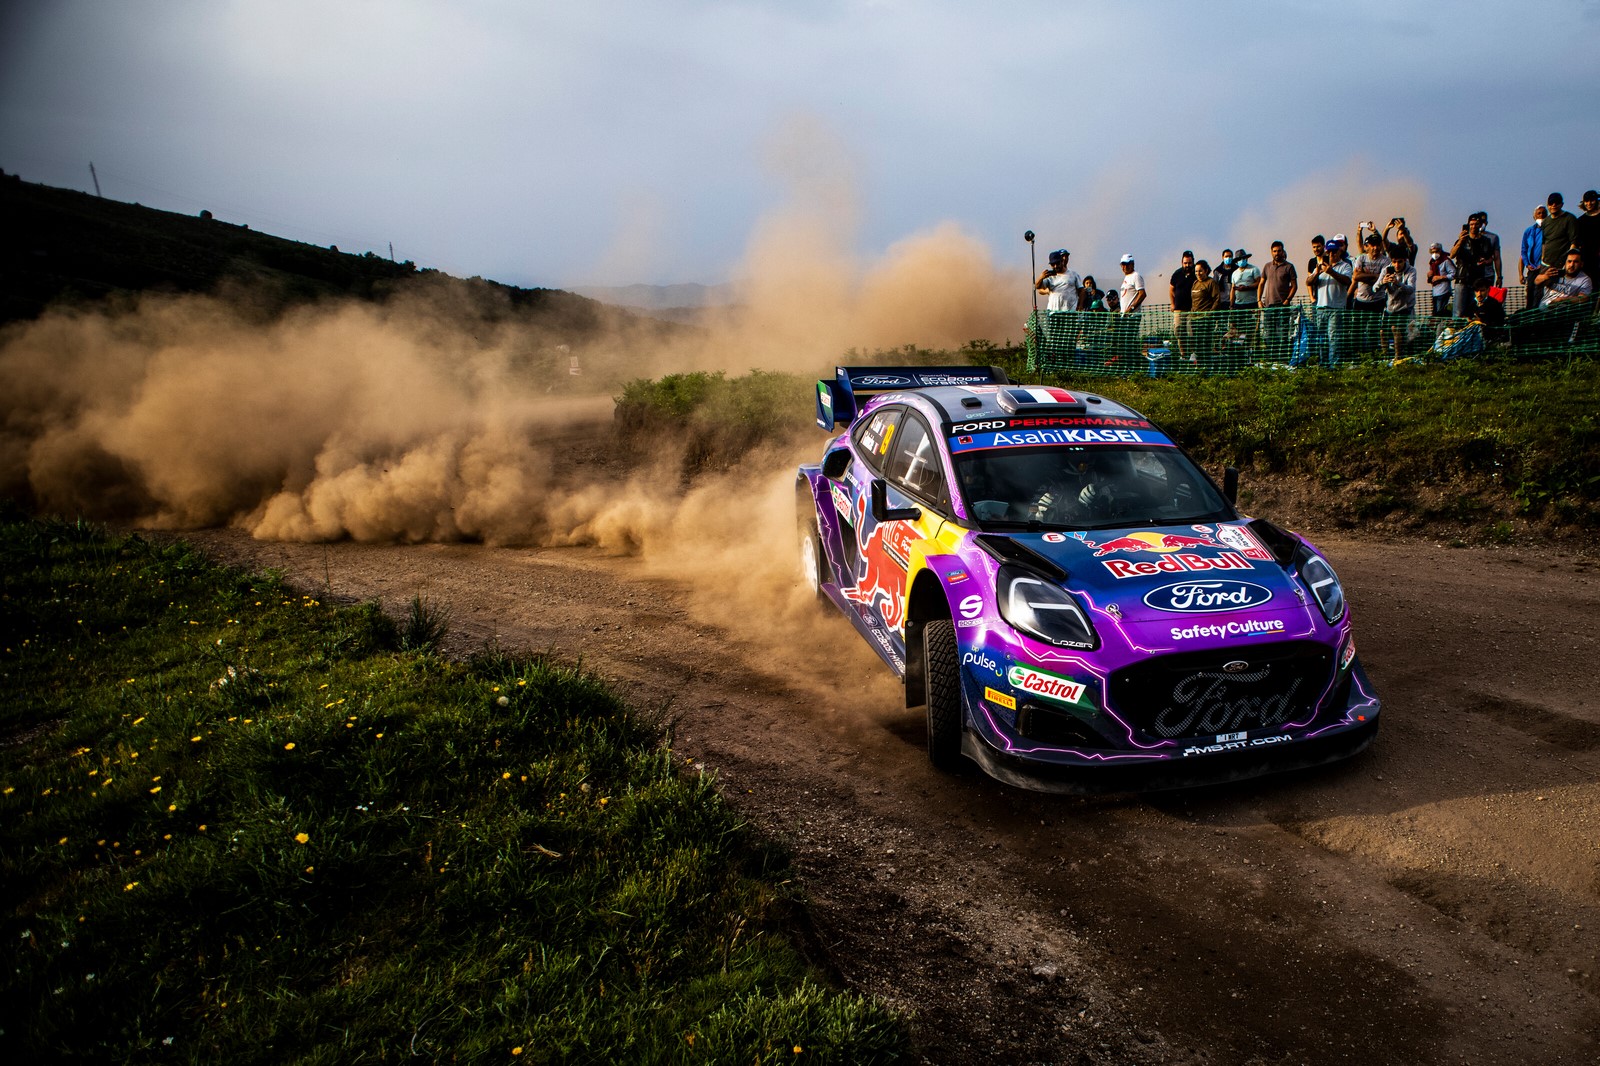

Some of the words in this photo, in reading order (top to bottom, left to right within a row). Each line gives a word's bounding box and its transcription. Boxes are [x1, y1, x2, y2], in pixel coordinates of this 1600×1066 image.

[861, 376, 901, 385] Ford
[952, 420, 1006, 434] FORD
[1009, 418, 1152, 428] PERFORMANCE
[1104, 554, 1186, 578] Red
[1178, 552, 1252, 571] Bull
[1170, 582, 1252, 608] Ford
[1170, 619, 1284, 640] SafetyCulture
[971, 645, 980, 653] bp
[962, 652, 996, 672] pulse
[1023, 673, 1080, 700] Castrol
[987, 690, 1013, 707] PIRELLI
[1154, 668, 1303, 737] Ford
